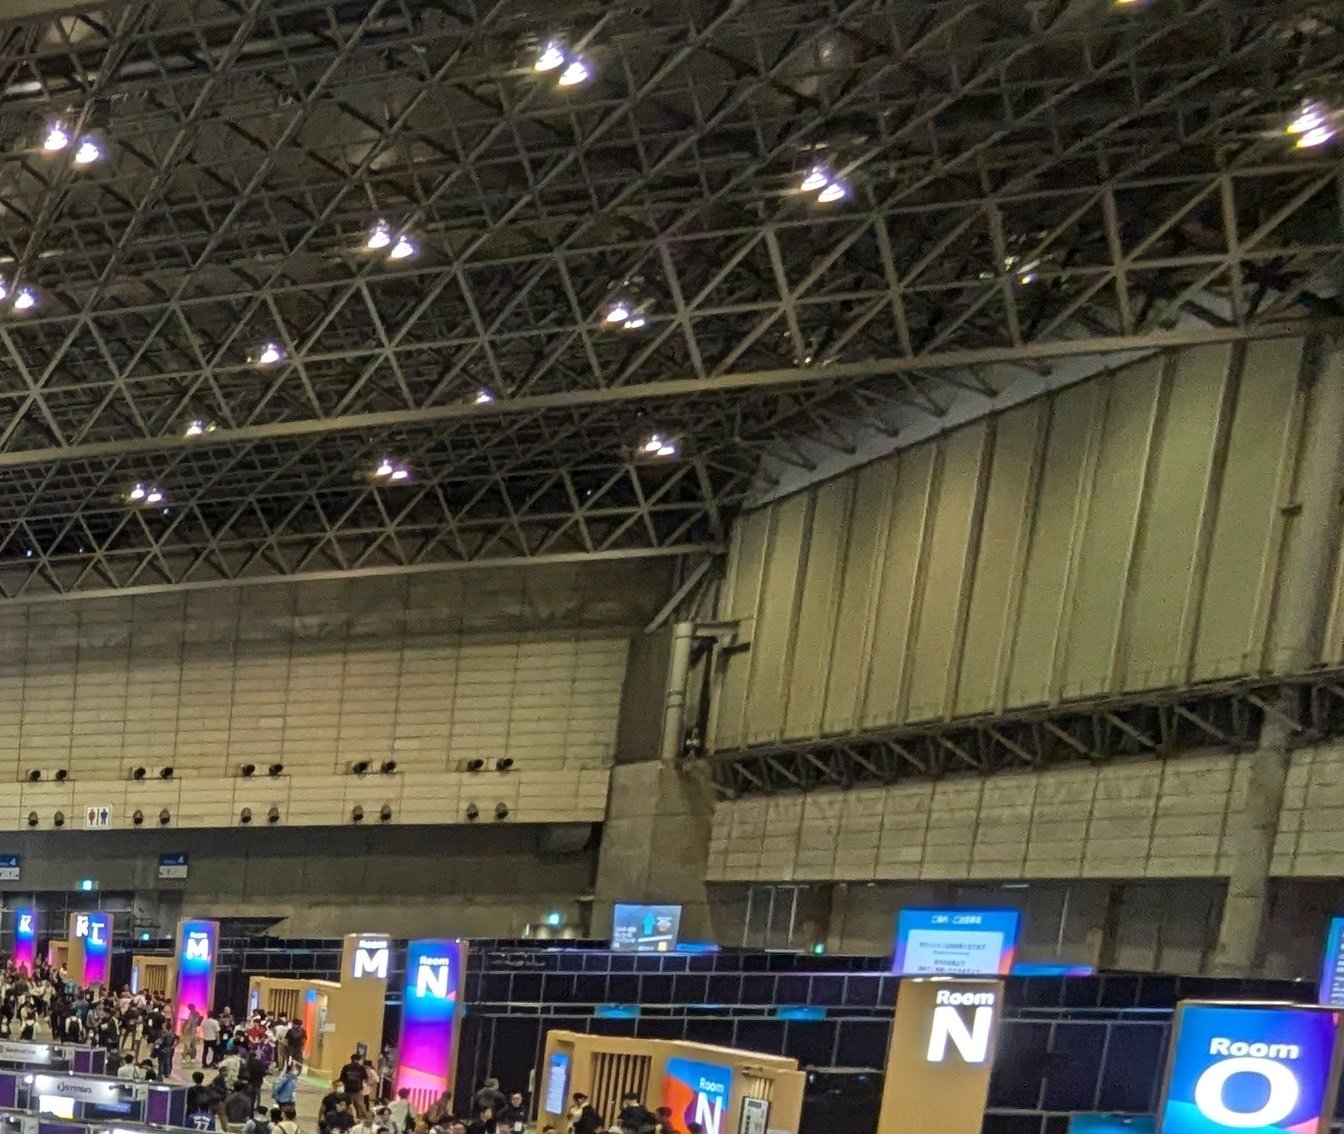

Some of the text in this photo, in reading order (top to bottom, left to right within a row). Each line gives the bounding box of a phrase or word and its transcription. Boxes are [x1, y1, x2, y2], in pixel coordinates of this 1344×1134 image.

[186, 939, 209, 960] M
[353, 949, 389, 978] M
[419, 956, 449, 967] Room
[415, 967, 449, 999] N
[936, 989, 995, 1006] Room
[925, 1006, 994, 1064] N
[1209, 1037, 1300, 1060] Room
[698, 1077, 725, 1094] Room
[1194, 1057, 1300, 1129] O
